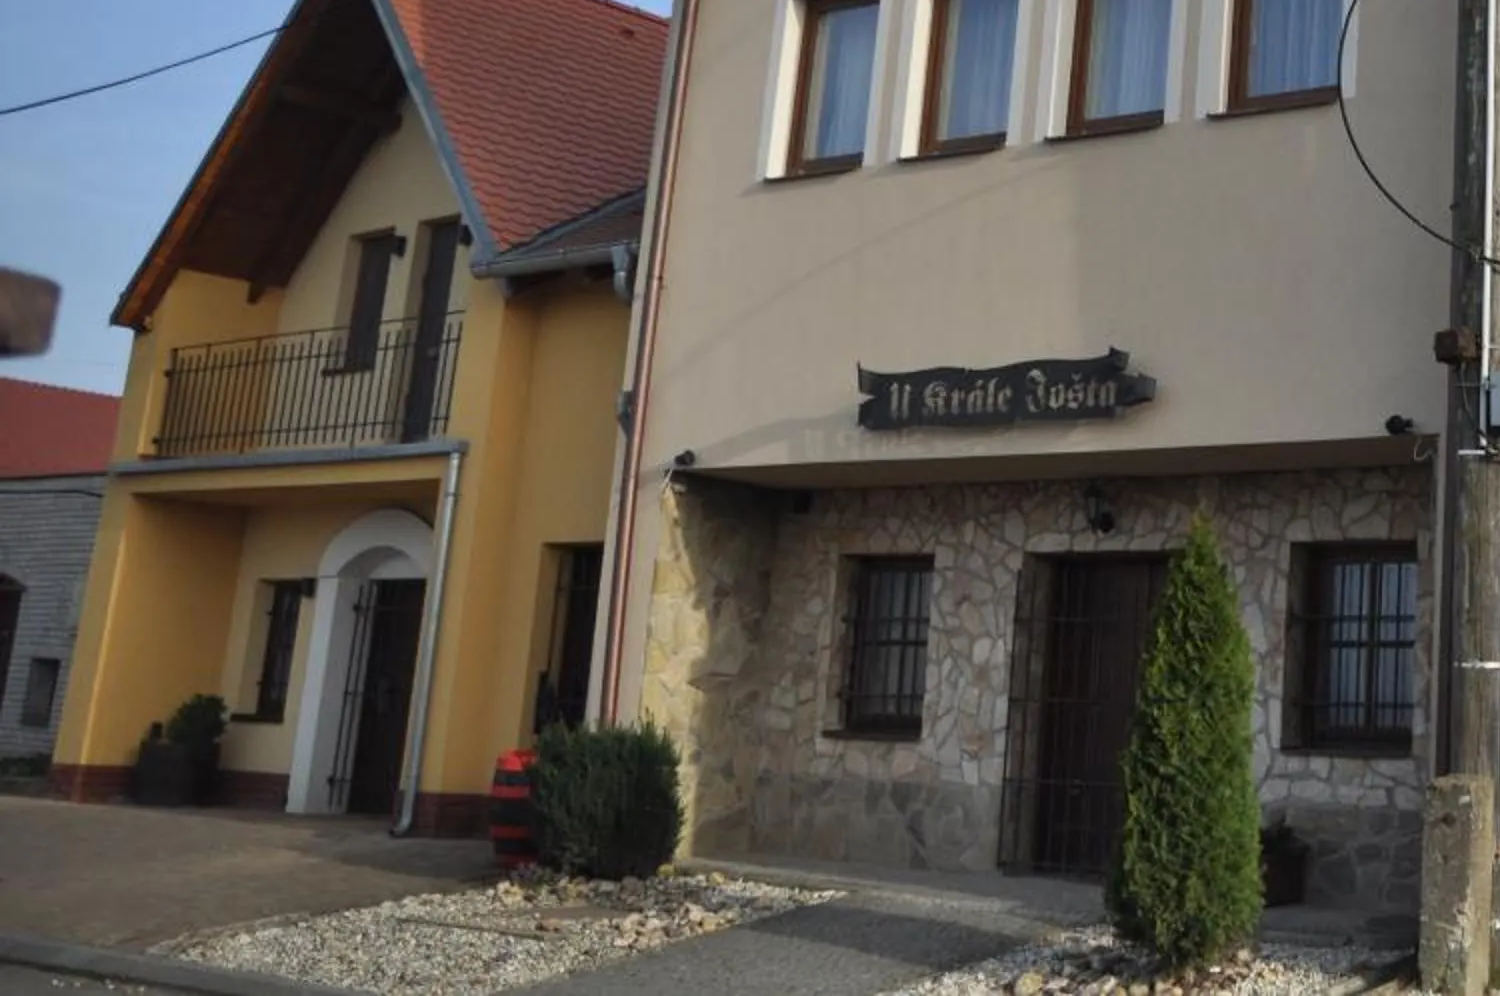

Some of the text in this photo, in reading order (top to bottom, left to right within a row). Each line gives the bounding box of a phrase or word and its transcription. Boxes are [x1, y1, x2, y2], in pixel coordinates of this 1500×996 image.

[889, 369, 1118, 420] U Krále Jošta
